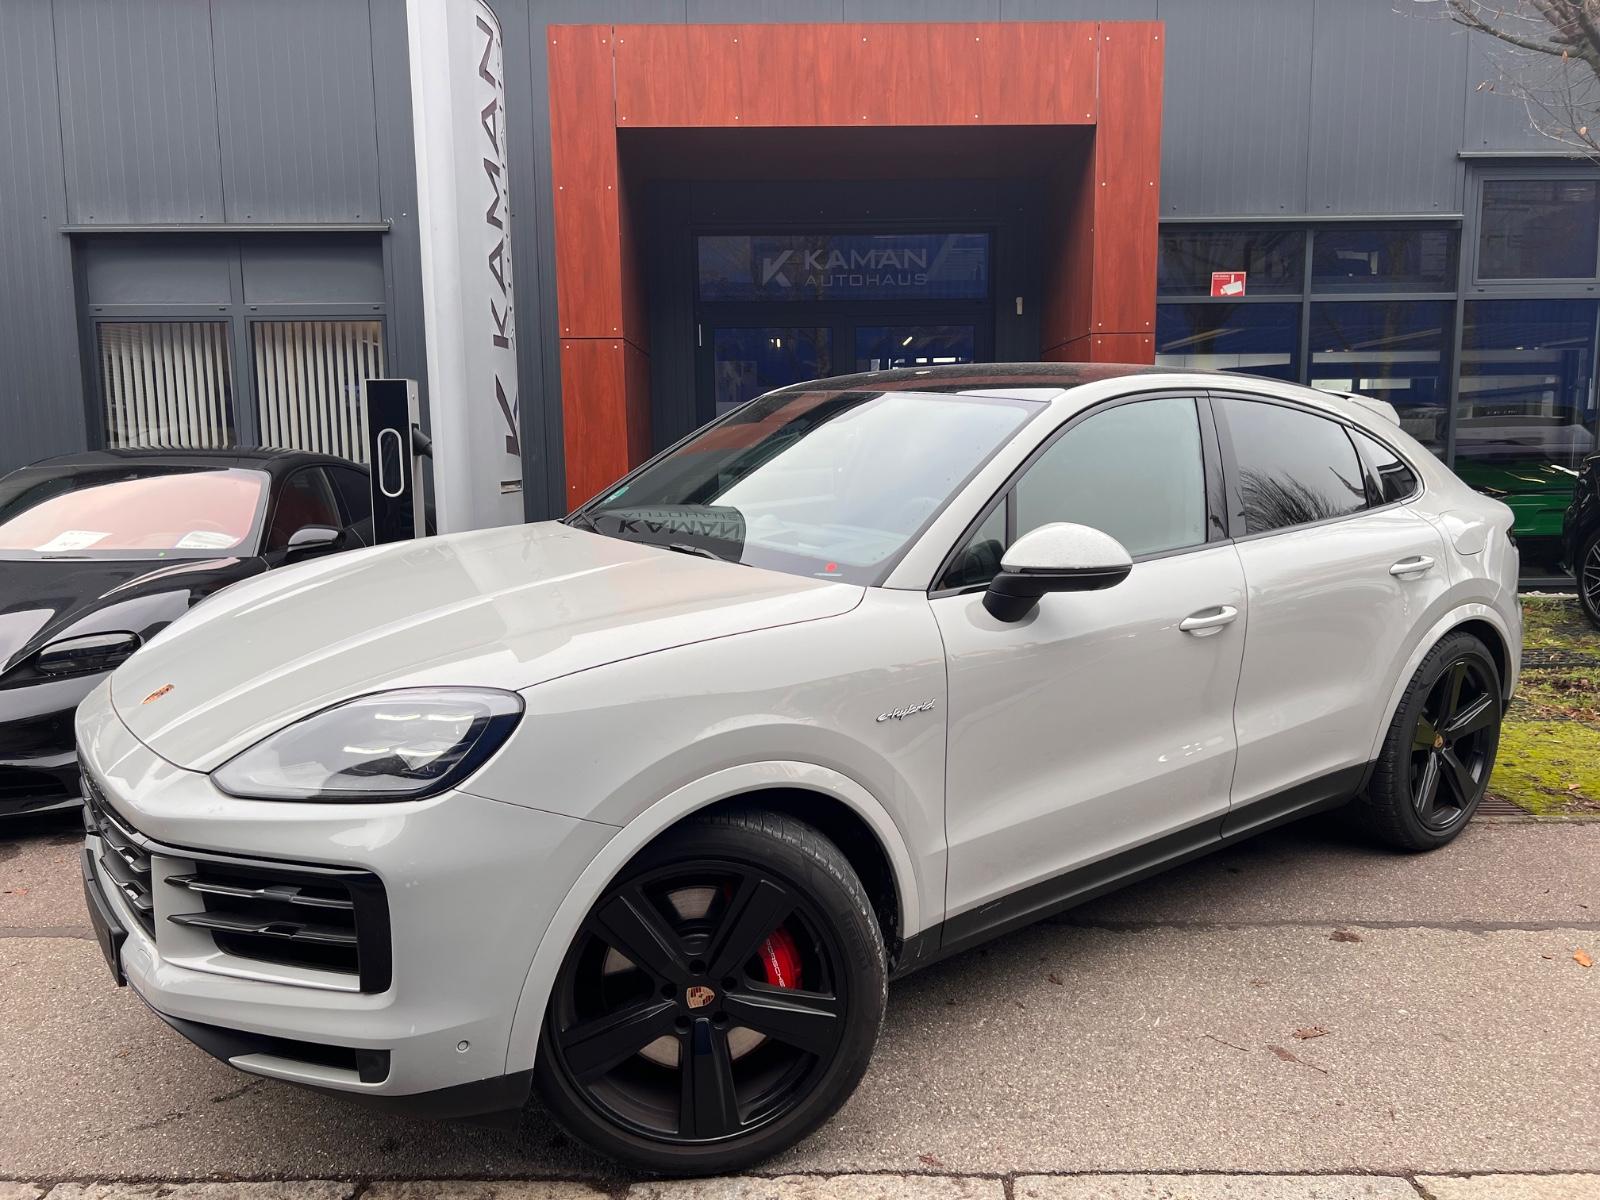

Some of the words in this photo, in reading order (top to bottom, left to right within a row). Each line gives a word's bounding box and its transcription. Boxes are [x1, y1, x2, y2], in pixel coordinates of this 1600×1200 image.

[476, 15, 509, 350] KAMAN
[803, 248, 927, 270] KAMAN
[805, 273, 929, 287] AUTOHAUS
